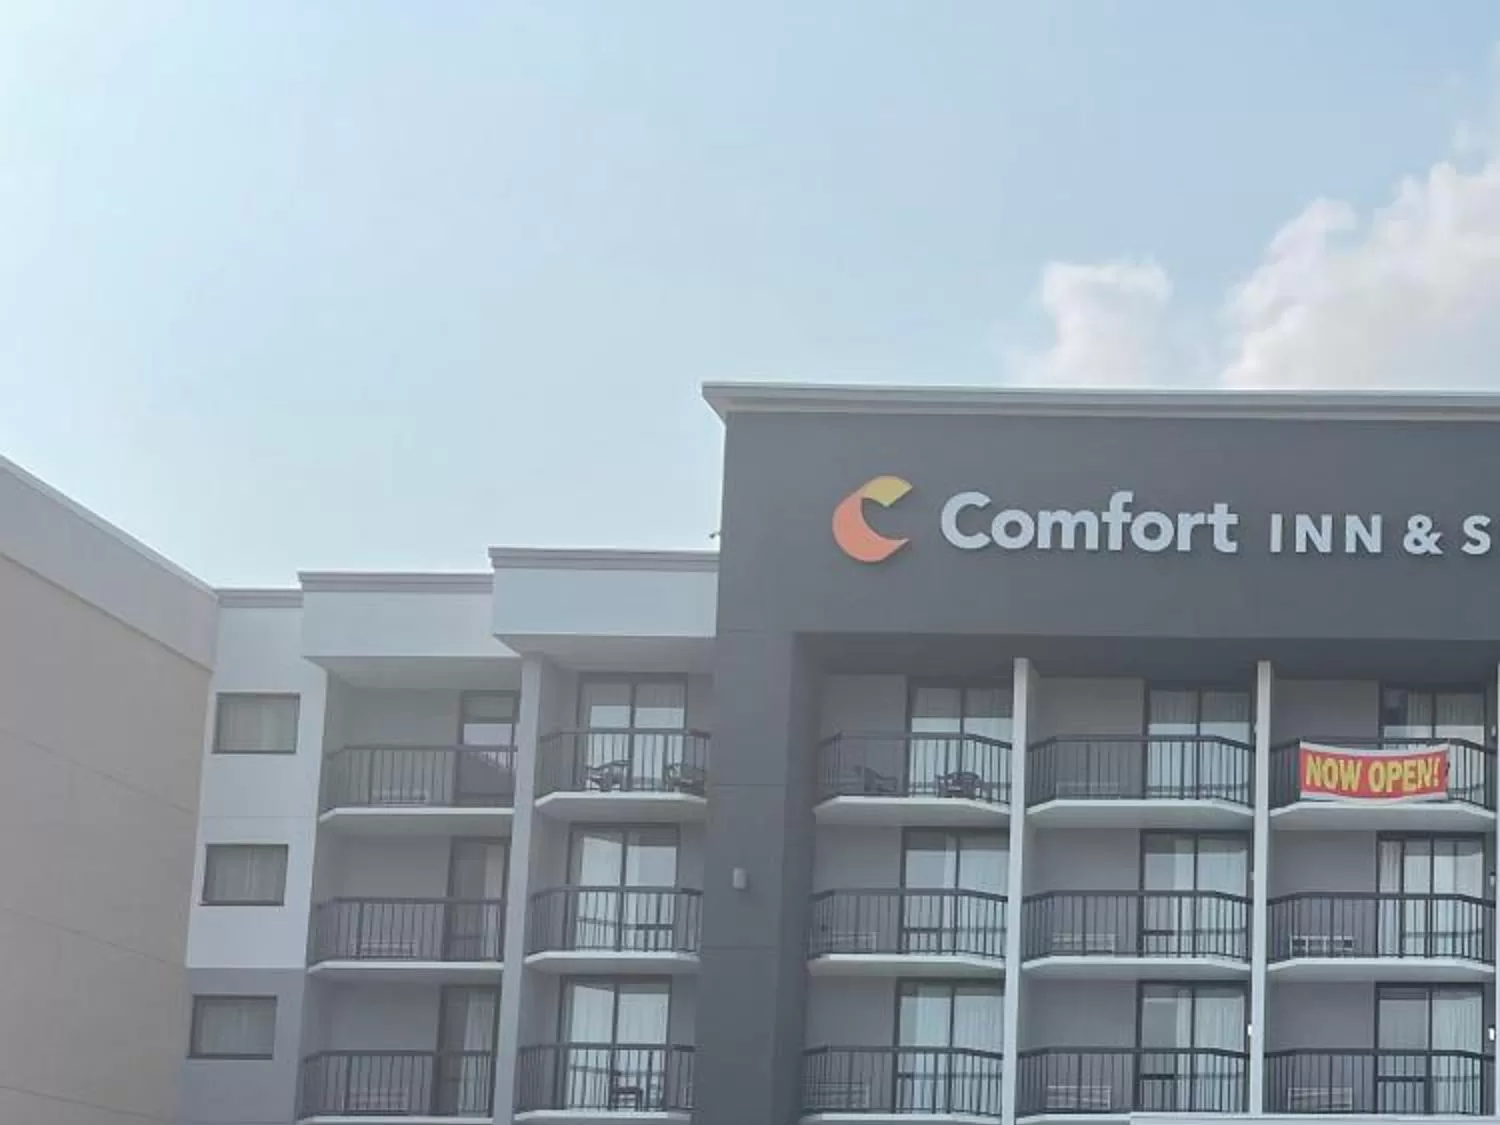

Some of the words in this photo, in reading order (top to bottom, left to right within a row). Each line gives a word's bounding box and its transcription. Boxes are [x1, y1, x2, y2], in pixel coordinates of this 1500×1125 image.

[941, 491, 1239, 553] Comfort
[1270, 513, 1383, 554] INN
[1403, 514, 1444, 556] &
[1305, 754, 1362, 792] NOW
[1368, 757, 1441, 793] OPEN!
